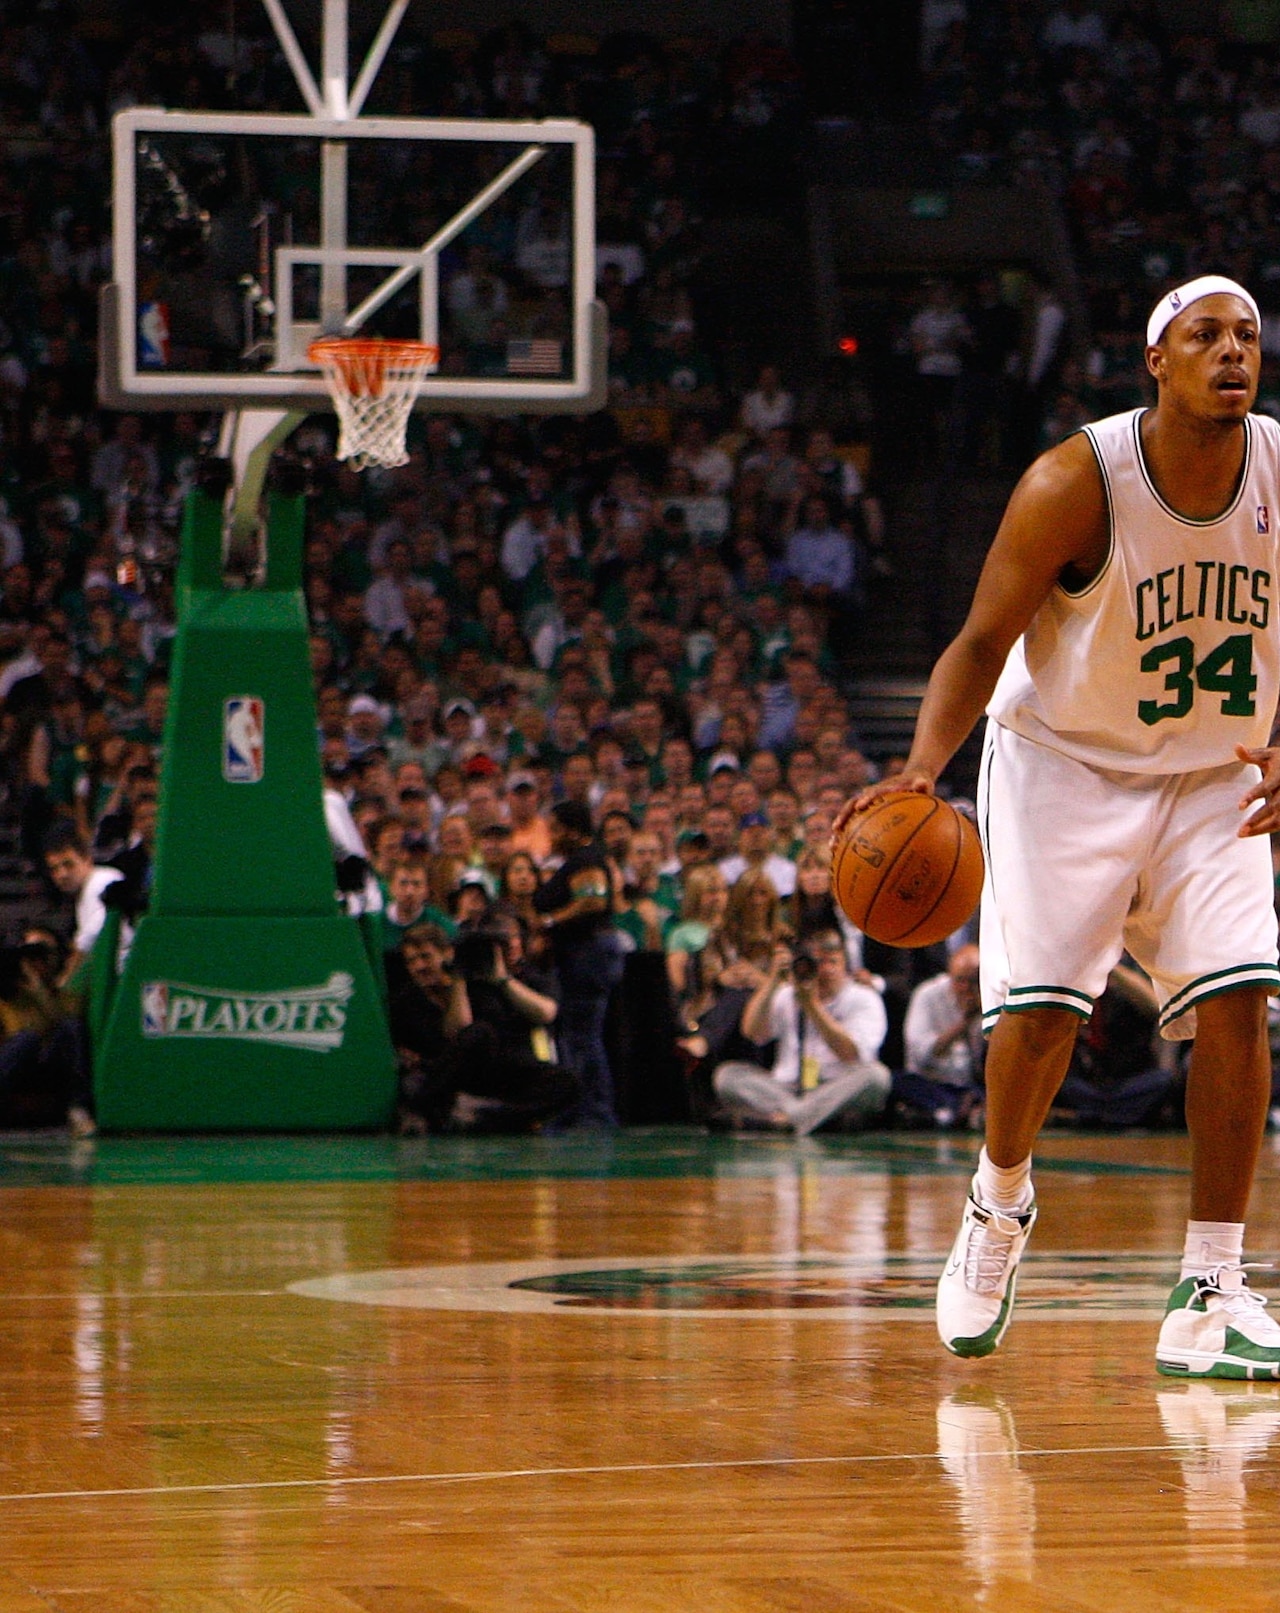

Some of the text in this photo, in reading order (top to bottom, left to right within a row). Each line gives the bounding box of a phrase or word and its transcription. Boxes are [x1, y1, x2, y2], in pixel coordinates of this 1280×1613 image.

[1135, 561, 1271, 642] CELTICS
[1137, 633, 1258, 727] 34
[168, 996, 347, 1033] PLAYOFFS
